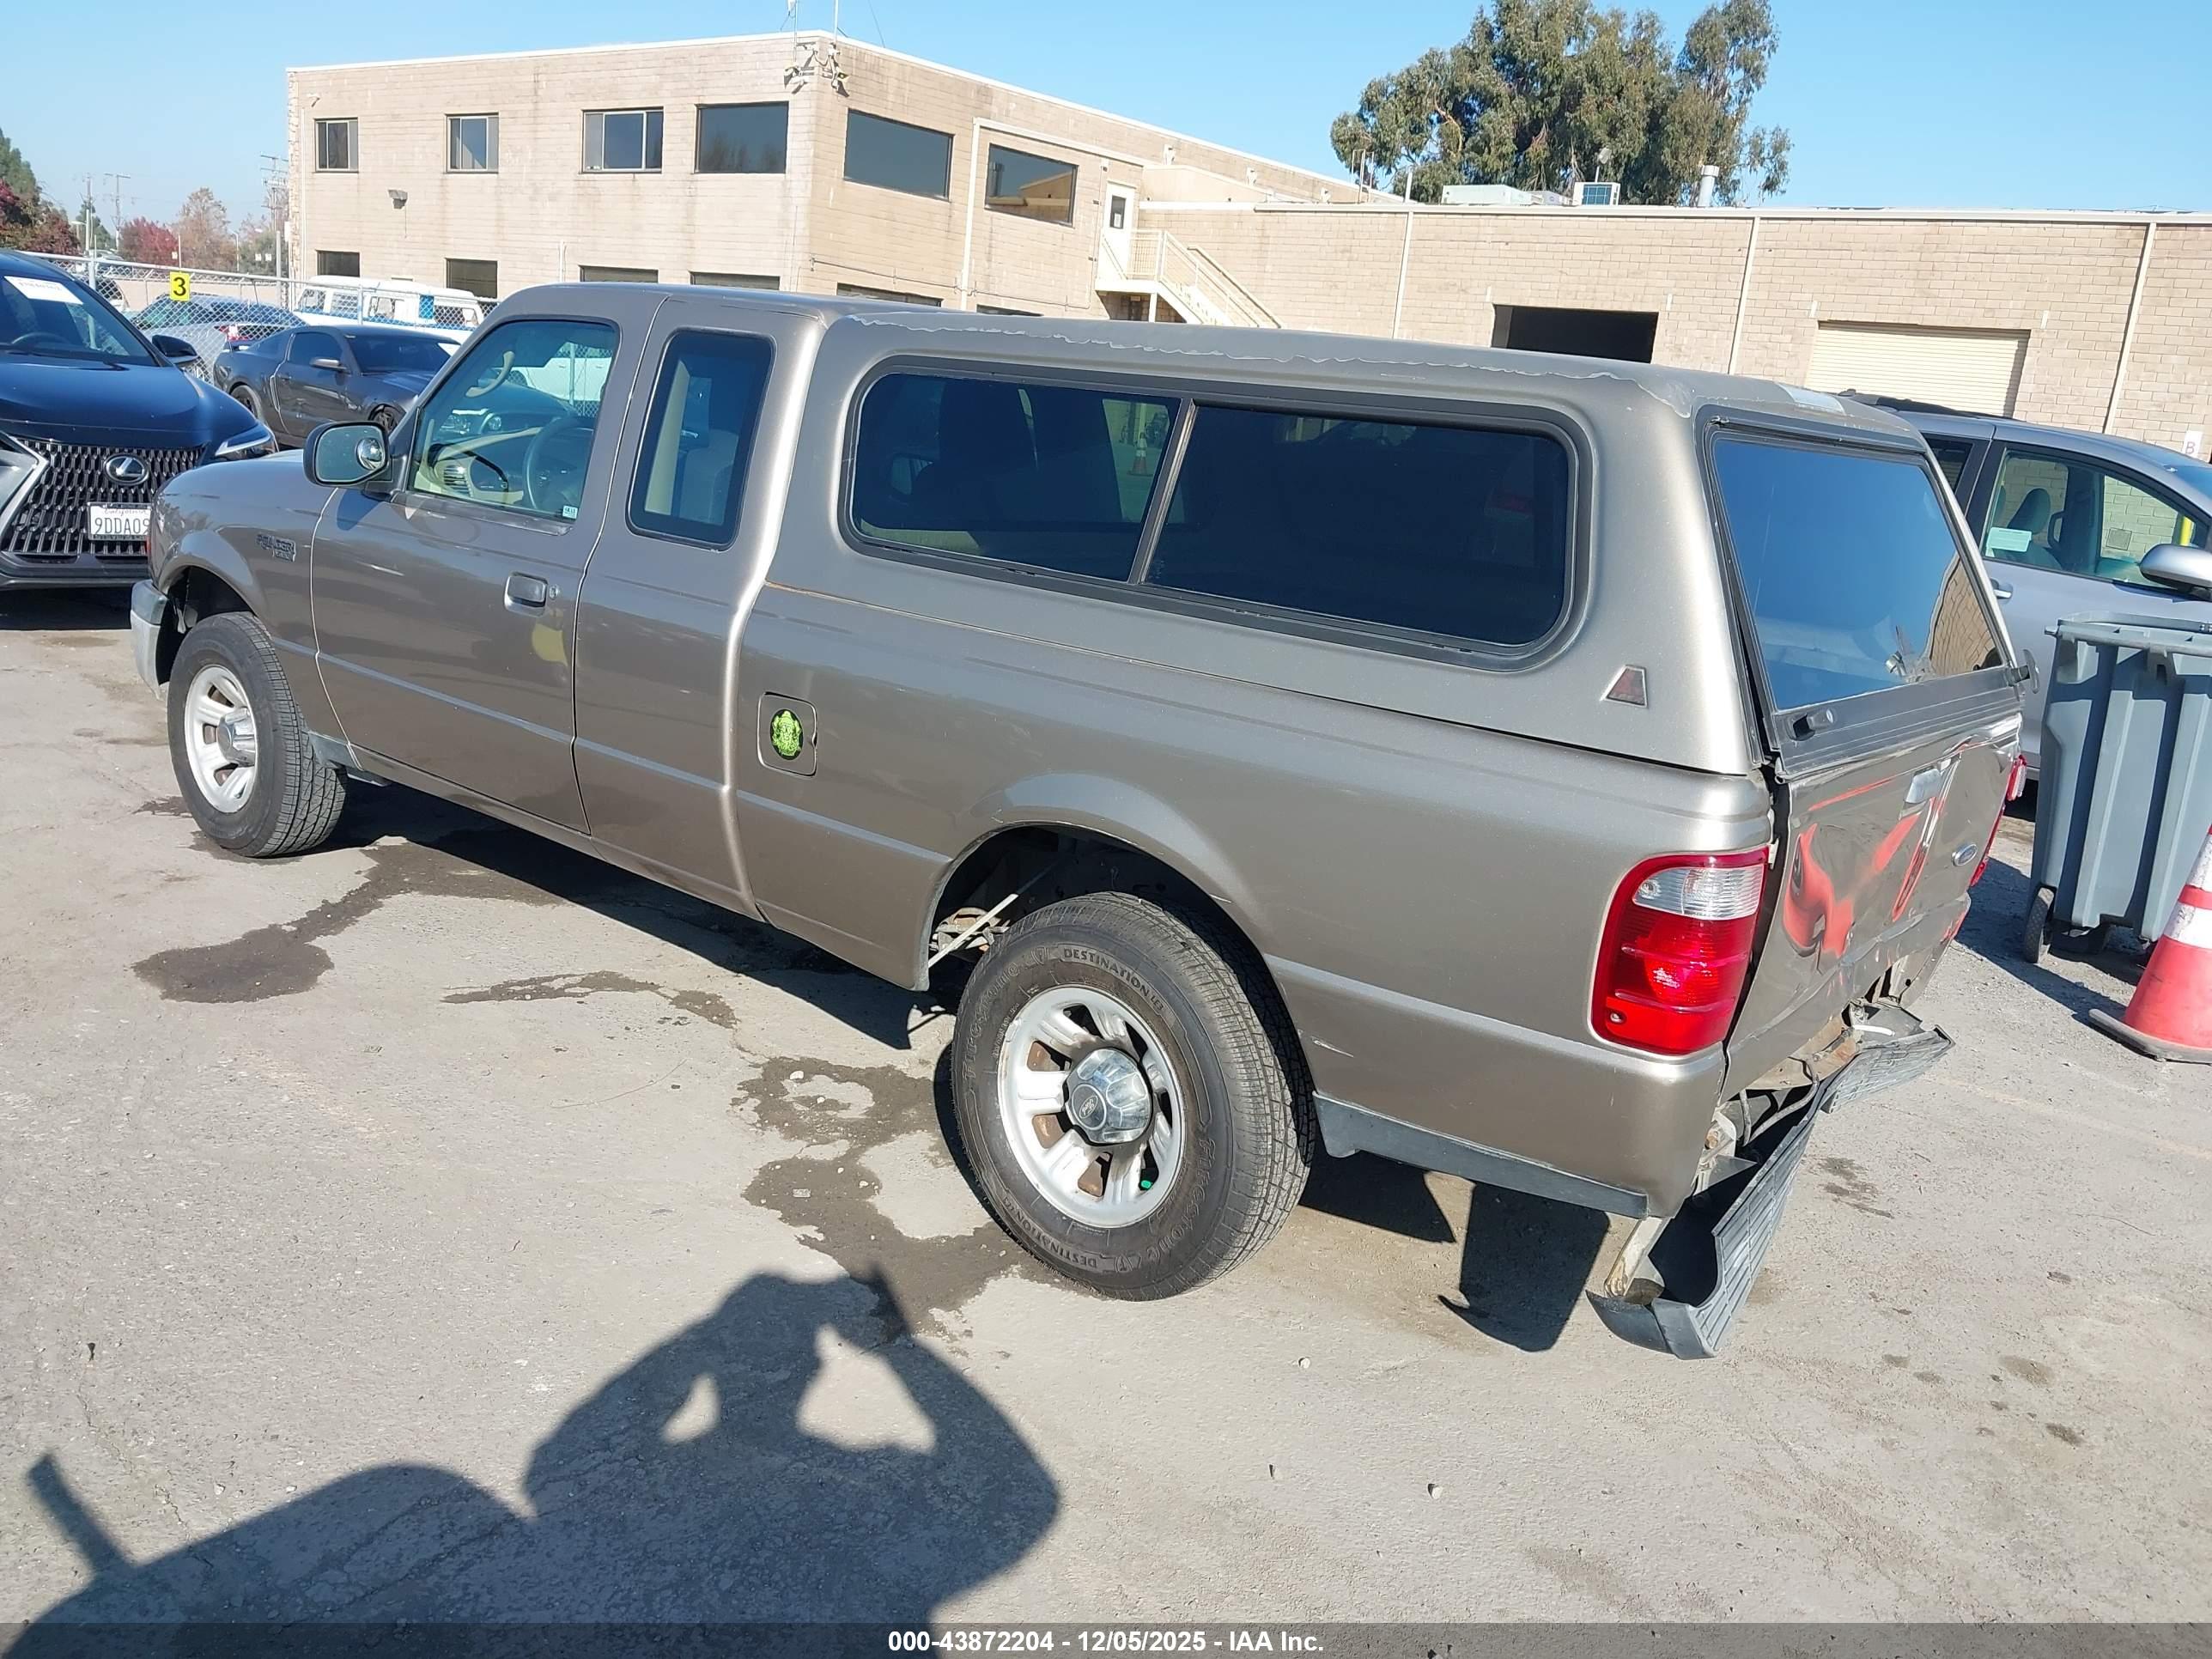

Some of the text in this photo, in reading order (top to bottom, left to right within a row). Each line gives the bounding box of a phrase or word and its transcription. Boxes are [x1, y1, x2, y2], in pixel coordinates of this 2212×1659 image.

[173, 276, 186, 296] 3
[2185, 441, 2196, 454] B
[1063, 947, 1151, 997] DESTINATION
